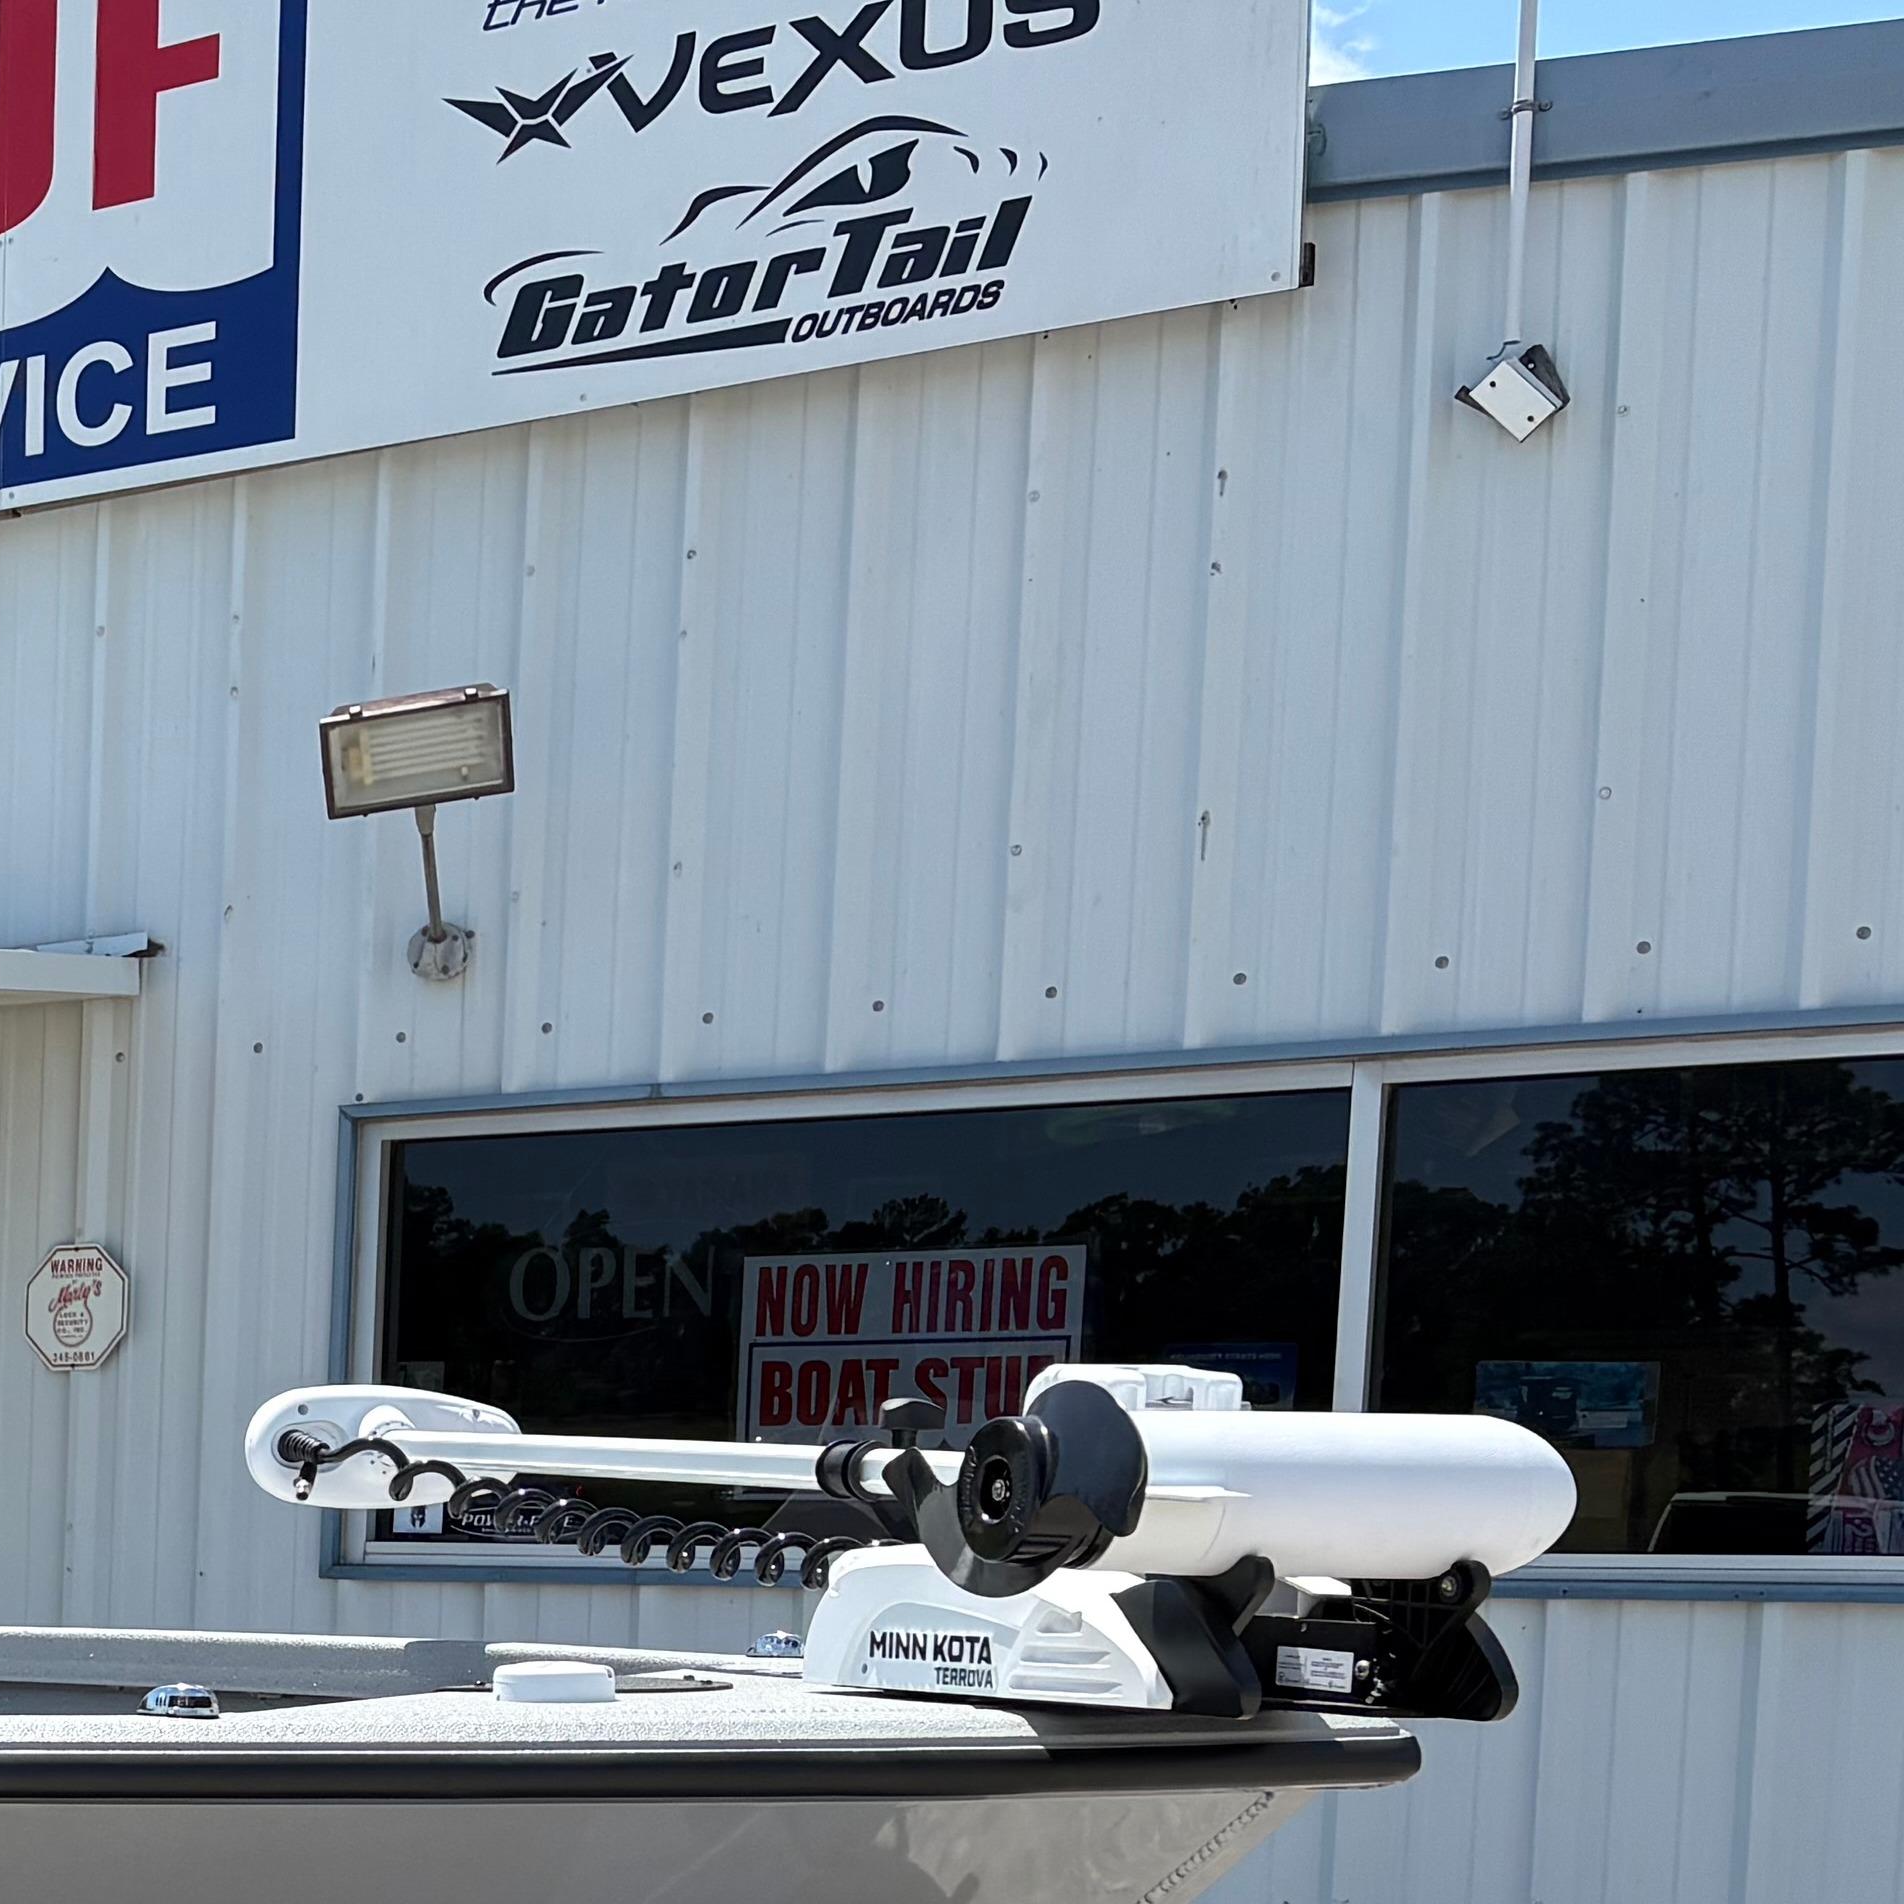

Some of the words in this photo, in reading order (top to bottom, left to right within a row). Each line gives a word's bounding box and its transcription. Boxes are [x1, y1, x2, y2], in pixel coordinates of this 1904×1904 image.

[791, 279, 1005, 343] OUTBOARDS
[51, 1257, 103, 1274] WARNING
[508, 1246, 717, 1323] OPEN
[755, 1263, 870, 1337] NOW
[892, 1255, 1069, 1334] HIRING
[759, 1358, 900, 1427] BOAT
[869, 1630, 927, 1661] MINN
[932, 1633, 992, 1665] KOTA
[934, 1666, 993, 1688] TERROVA
